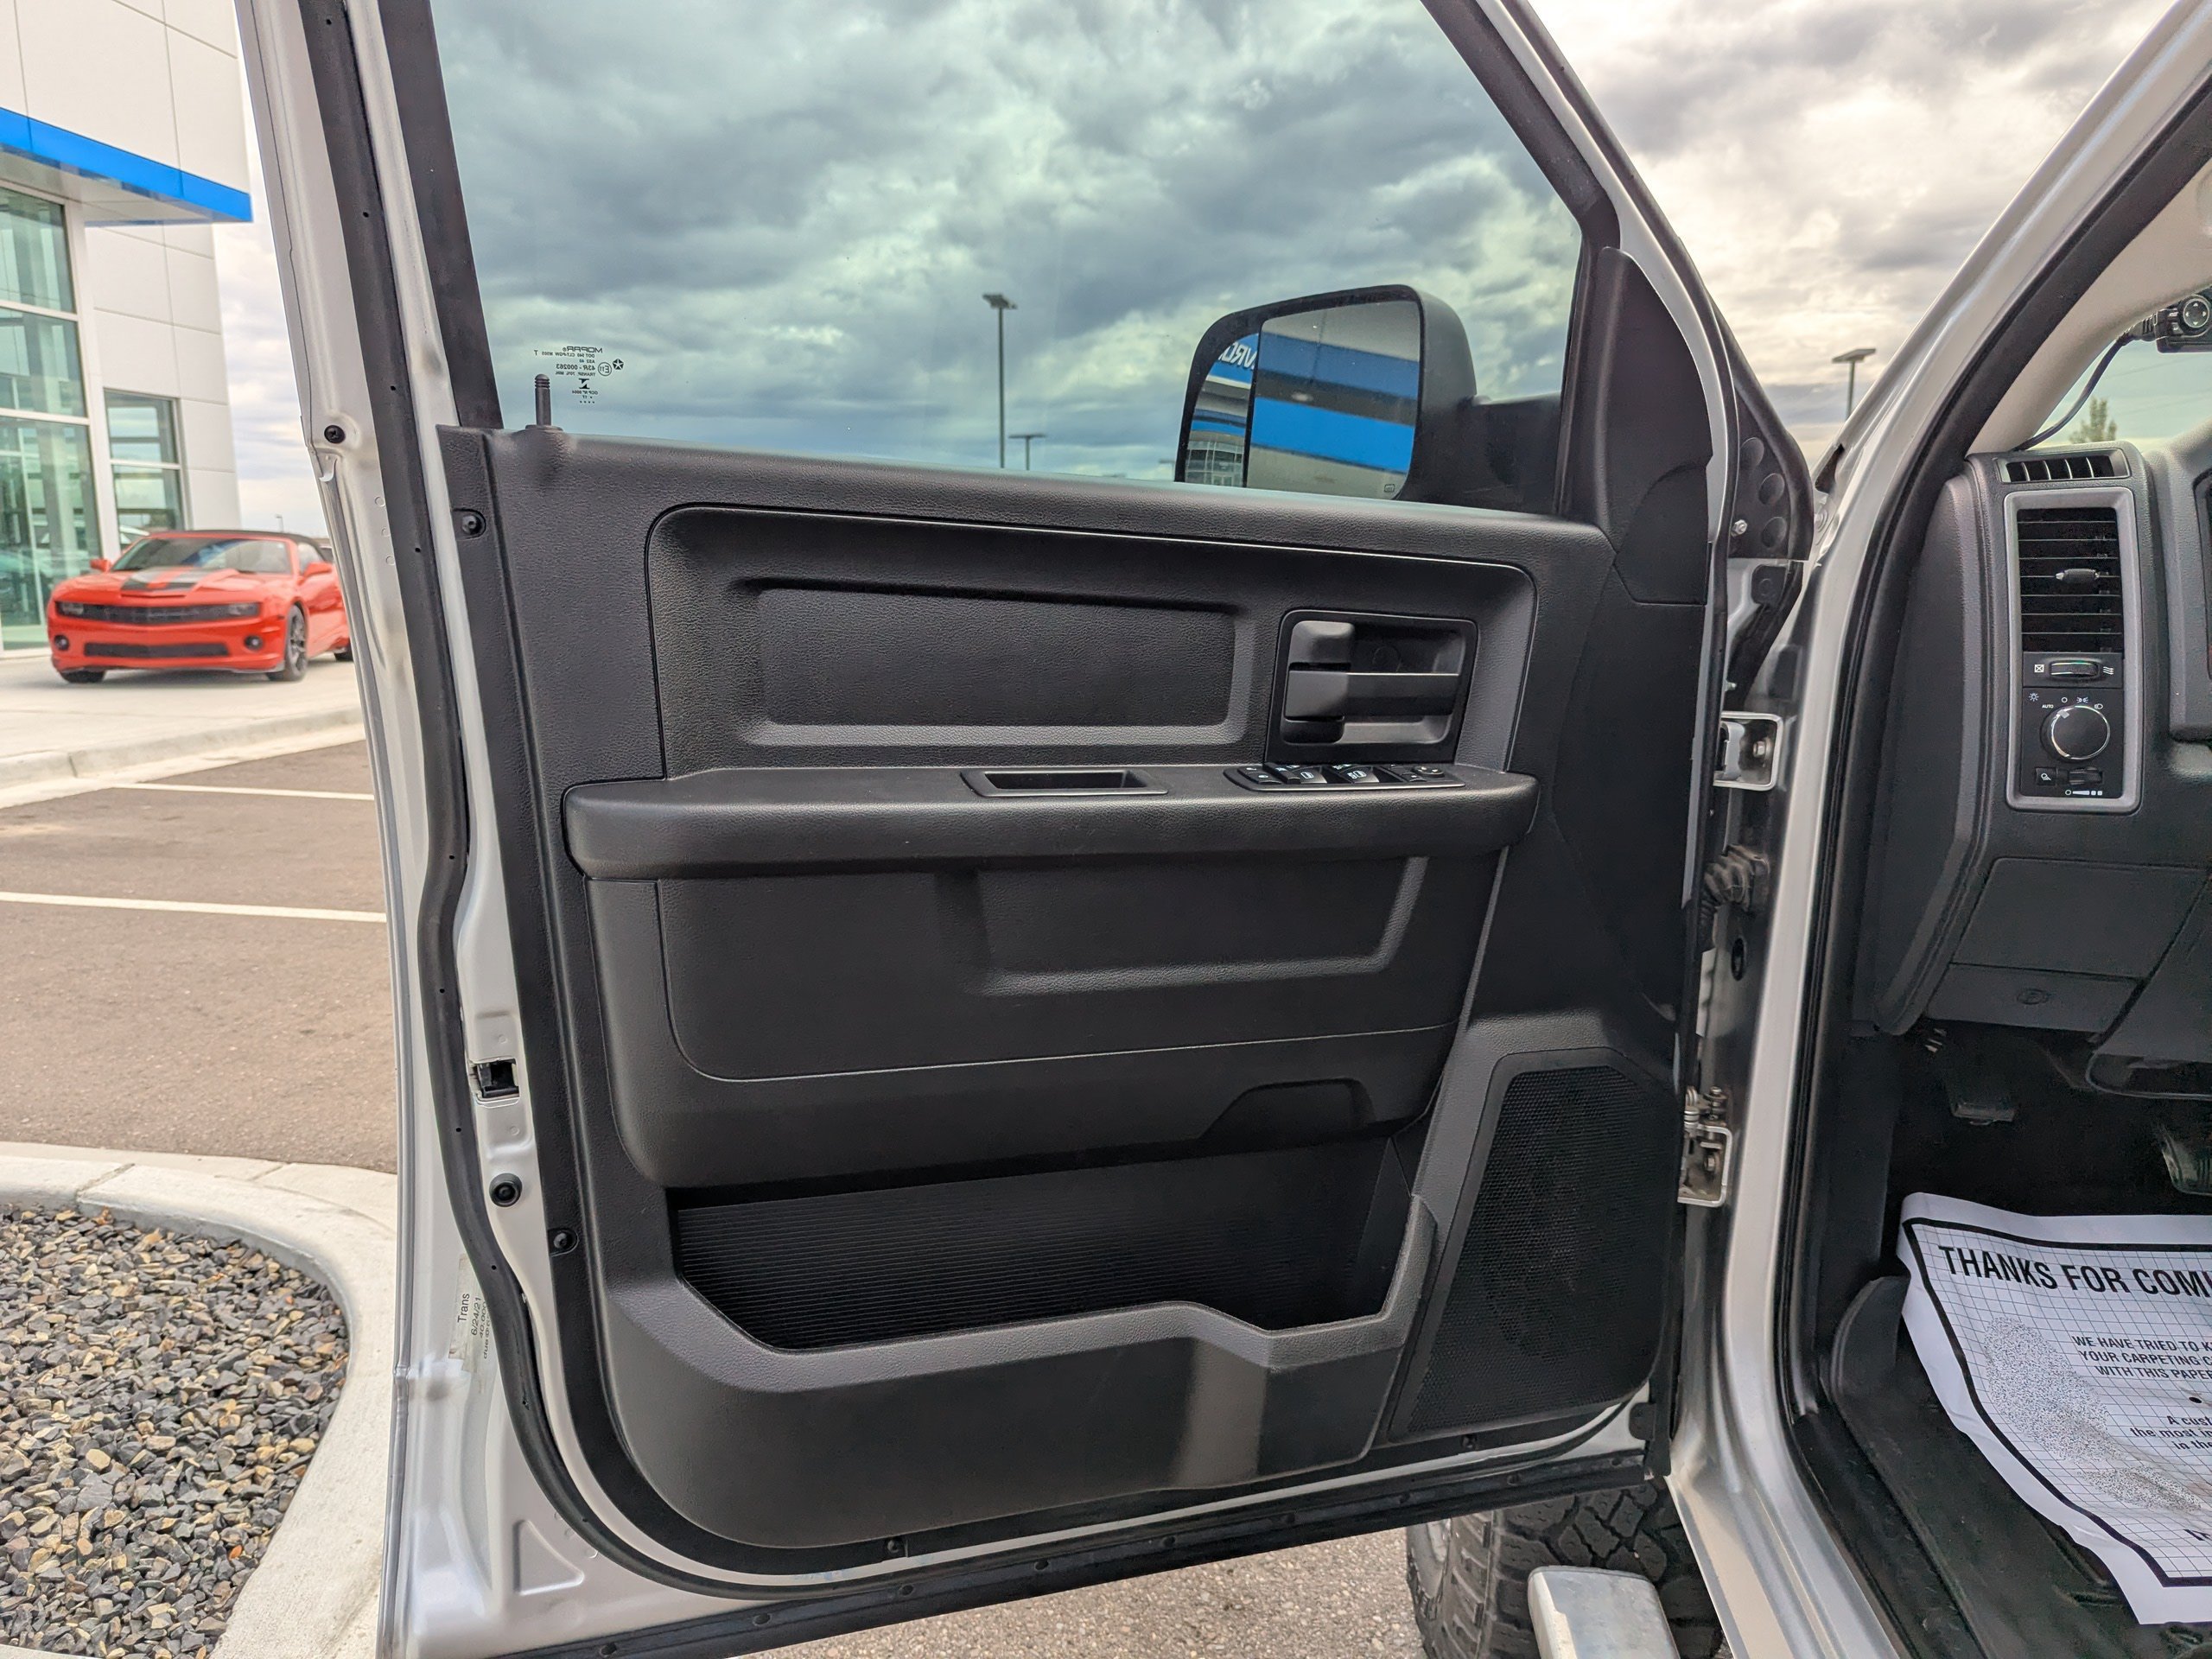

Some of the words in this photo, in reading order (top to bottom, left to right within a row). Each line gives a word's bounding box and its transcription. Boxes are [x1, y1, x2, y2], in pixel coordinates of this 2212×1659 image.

[1938, 1245, 2057, 1289] THANKS
[2060, 1264, 2132, 1294] FOR
[457, 1293, 470, 1323] Trans
[471, 1297, 481, 1336] 6/24/21
[2072, 1336, 2096, 1346] WE
[2096, 1338, 2135, 1349] HAVE
[2134, 1339, 2177, 1351] TRIED
[2177, 1341, 2200, 1351] TO
[2201, 1341, 2212, 1351] K
[2078, 1351, 2120, 1363] YOUR
[2121, 1352, 2201, 1365] CARPETING
[2094, 1365, 2134, 1376] WITH
[2133, 1367, 2169, 1378] THIS
[2166, 1415, 2180, 1425] A
[2130, 1427, 2156, 1437] the
[2158, 1428, 2198, 1438] most
[2171, 1440, 2190, 1450] in
